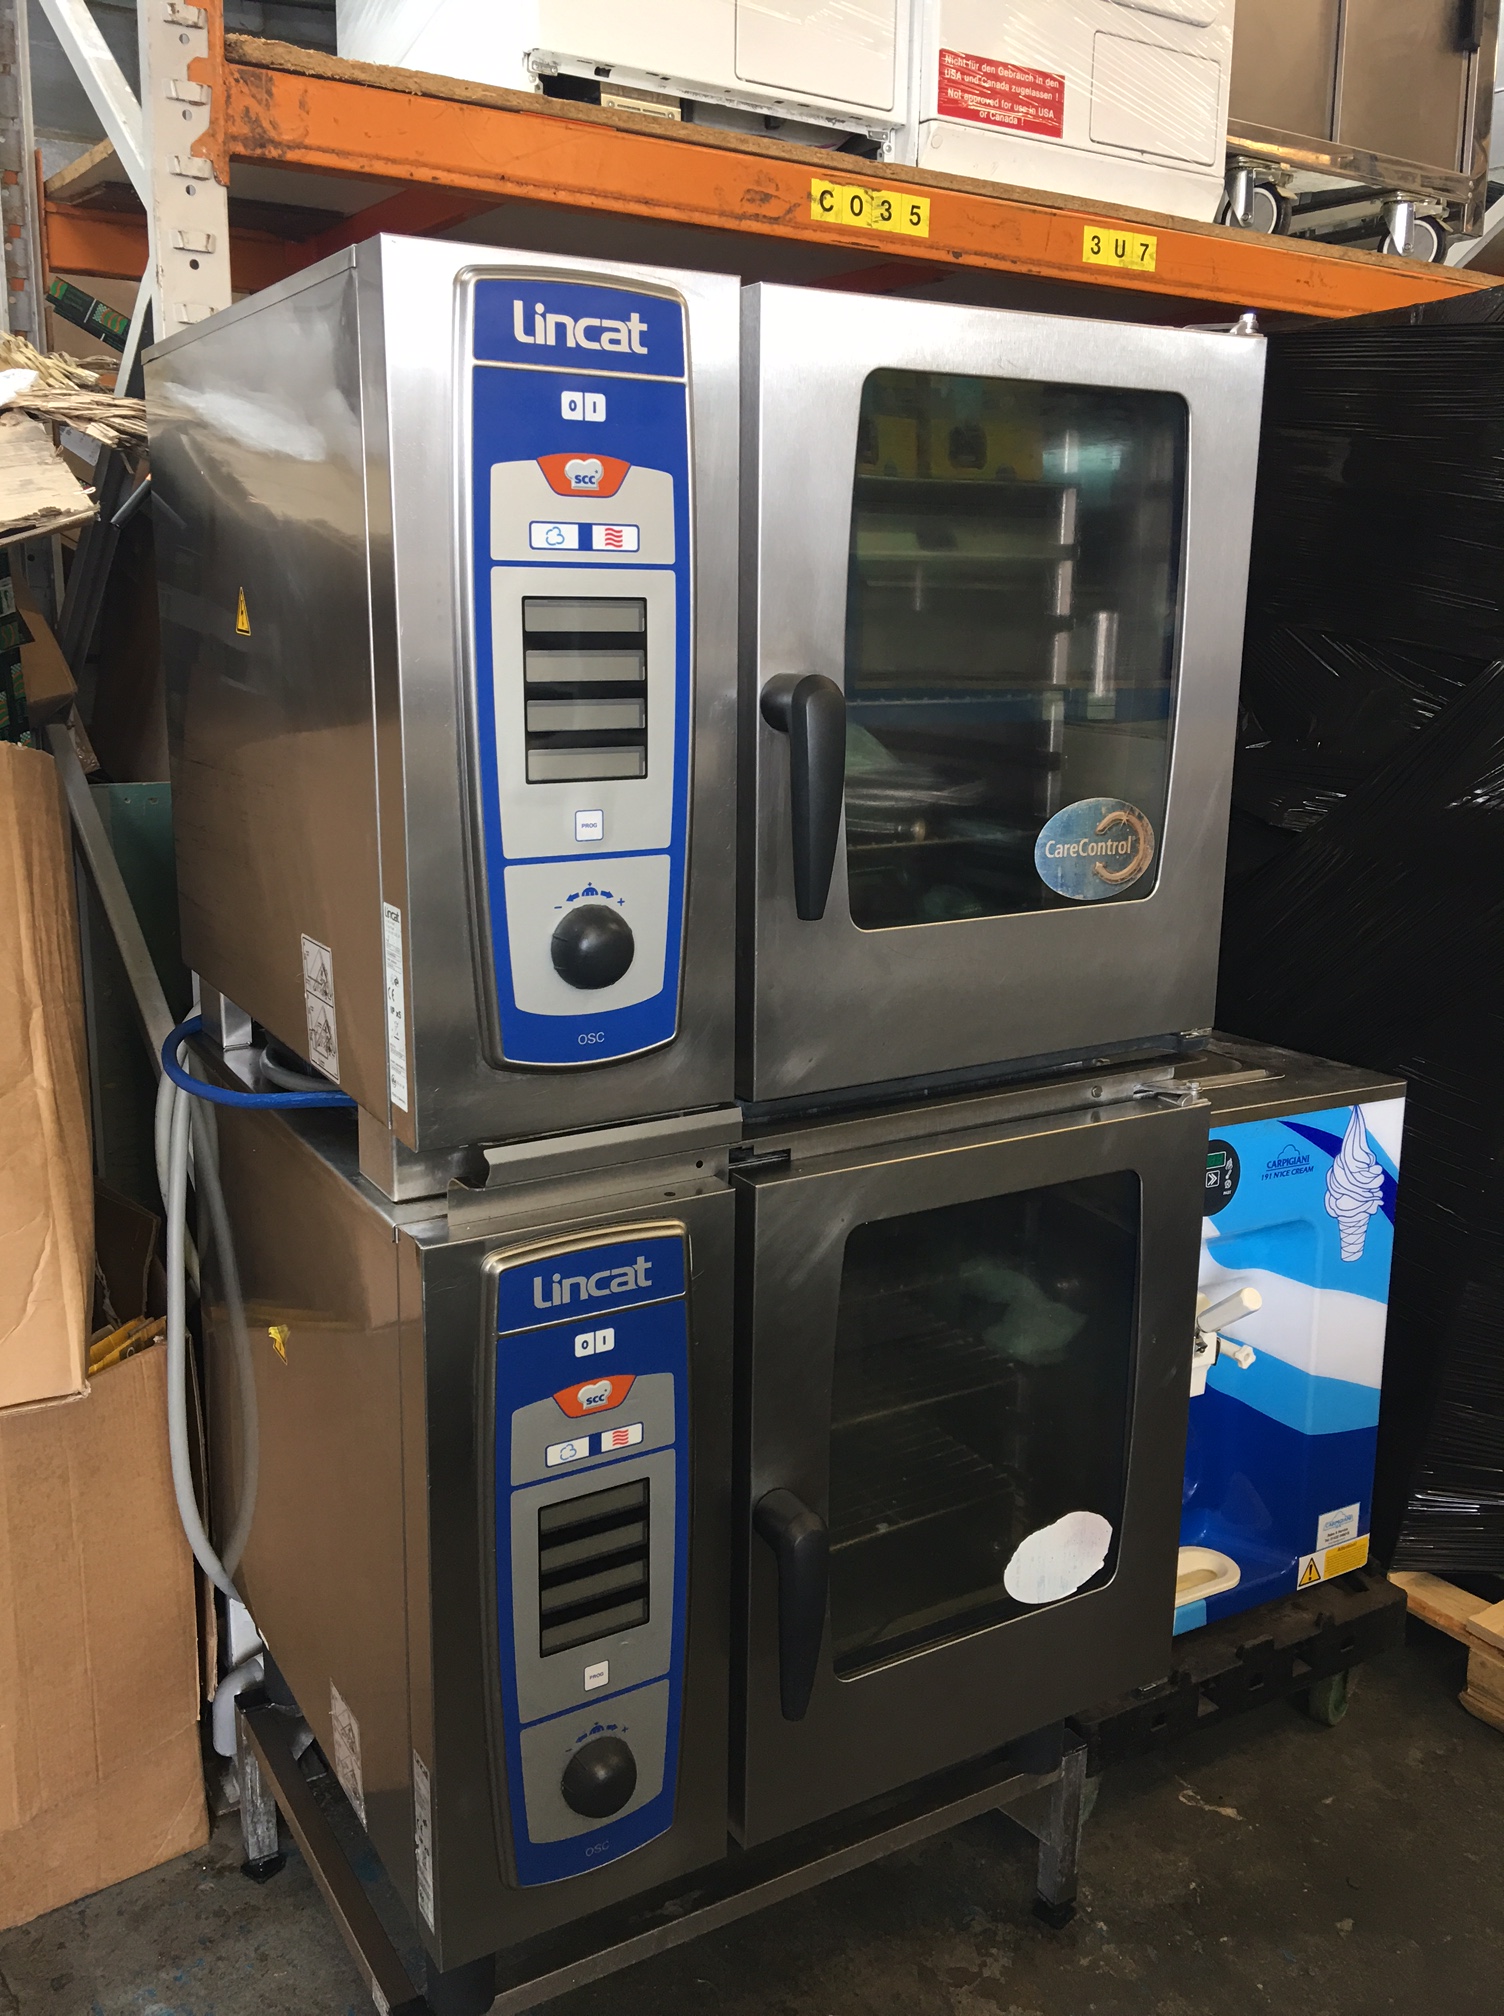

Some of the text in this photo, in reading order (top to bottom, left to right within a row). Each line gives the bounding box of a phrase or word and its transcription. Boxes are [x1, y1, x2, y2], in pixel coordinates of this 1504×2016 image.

[945, 54, 1059, 88] Nicht für den Gebrauch in den
[945, 69, 962, 81] USA
[964, 74, 979, 84] und
[980, 75, 1010, 91] Canada
[1011, 84, 1053, 101] zugelassen
[947, 88, 1055, 118] Not approved for use in USA
[979, 110, 988, 119] or
[989, 111, 1018, 125] Canada
[513, 299, 648, 355] Lincat
[1045, 835, 1132, 858] CareControl
[577, 1031, 605, 1045] OSC
[1266, 1154, 1310, 1169] CARPIGIANI
[1261, 1172, 1273, 1181] 191
[1291, 1166, 1314, 1176] CREAM
[533, 1255, 653, 1309] Lincat
[589, 1671, 604, 1680] PROG
[585, 1840, 610, 1857] OSC
